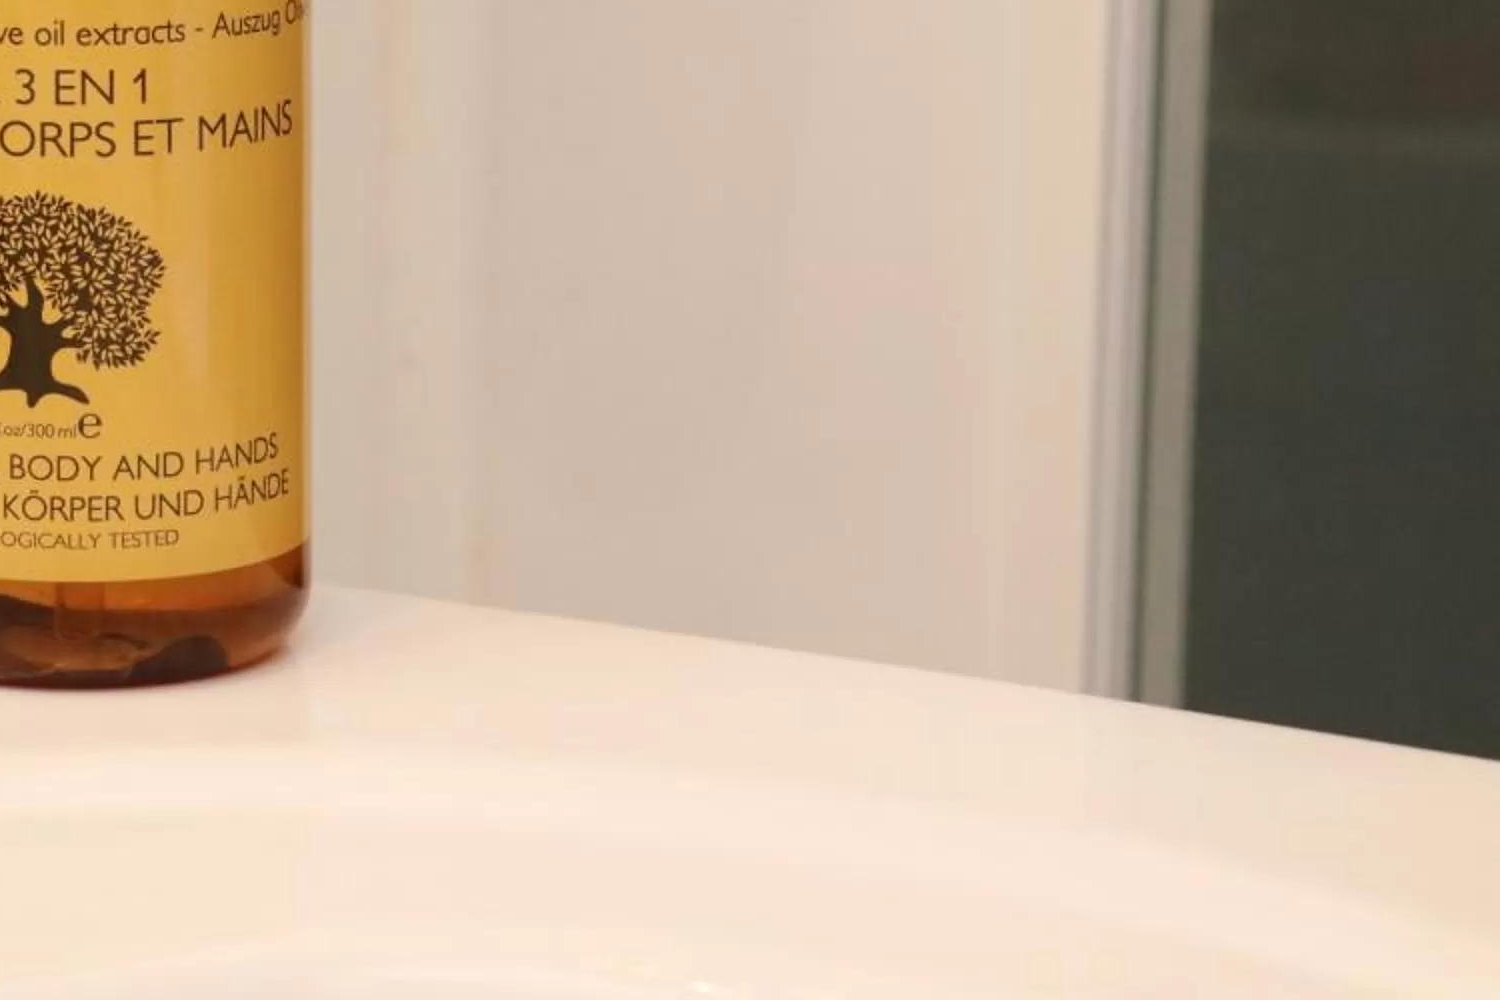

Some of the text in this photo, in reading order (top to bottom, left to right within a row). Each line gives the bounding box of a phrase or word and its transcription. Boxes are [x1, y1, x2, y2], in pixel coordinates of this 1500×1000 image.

[34, 20, 66, 47] oil
[75, 19, 187, 47] extracts
[211, 10, 281, 38] Auszug
[14, 67, 37, 106] 3
[54, 68, 115, 106] EN
[131, 67, 149, 105] 1
[133, 117, 185, 157] ET
[198, 98, 294, 152] MAINS
[9, 454, 103, 482] BODY
[111, 450, 185, 481] AND
[194, 432, 279, 476] HANDS
[3, 489, 125, 523] KÖRPER
[134, 490, 205, 520] UND
[214, 467, 290, 513] HÄNDE
[108, 528, 180, 551] TESTED
